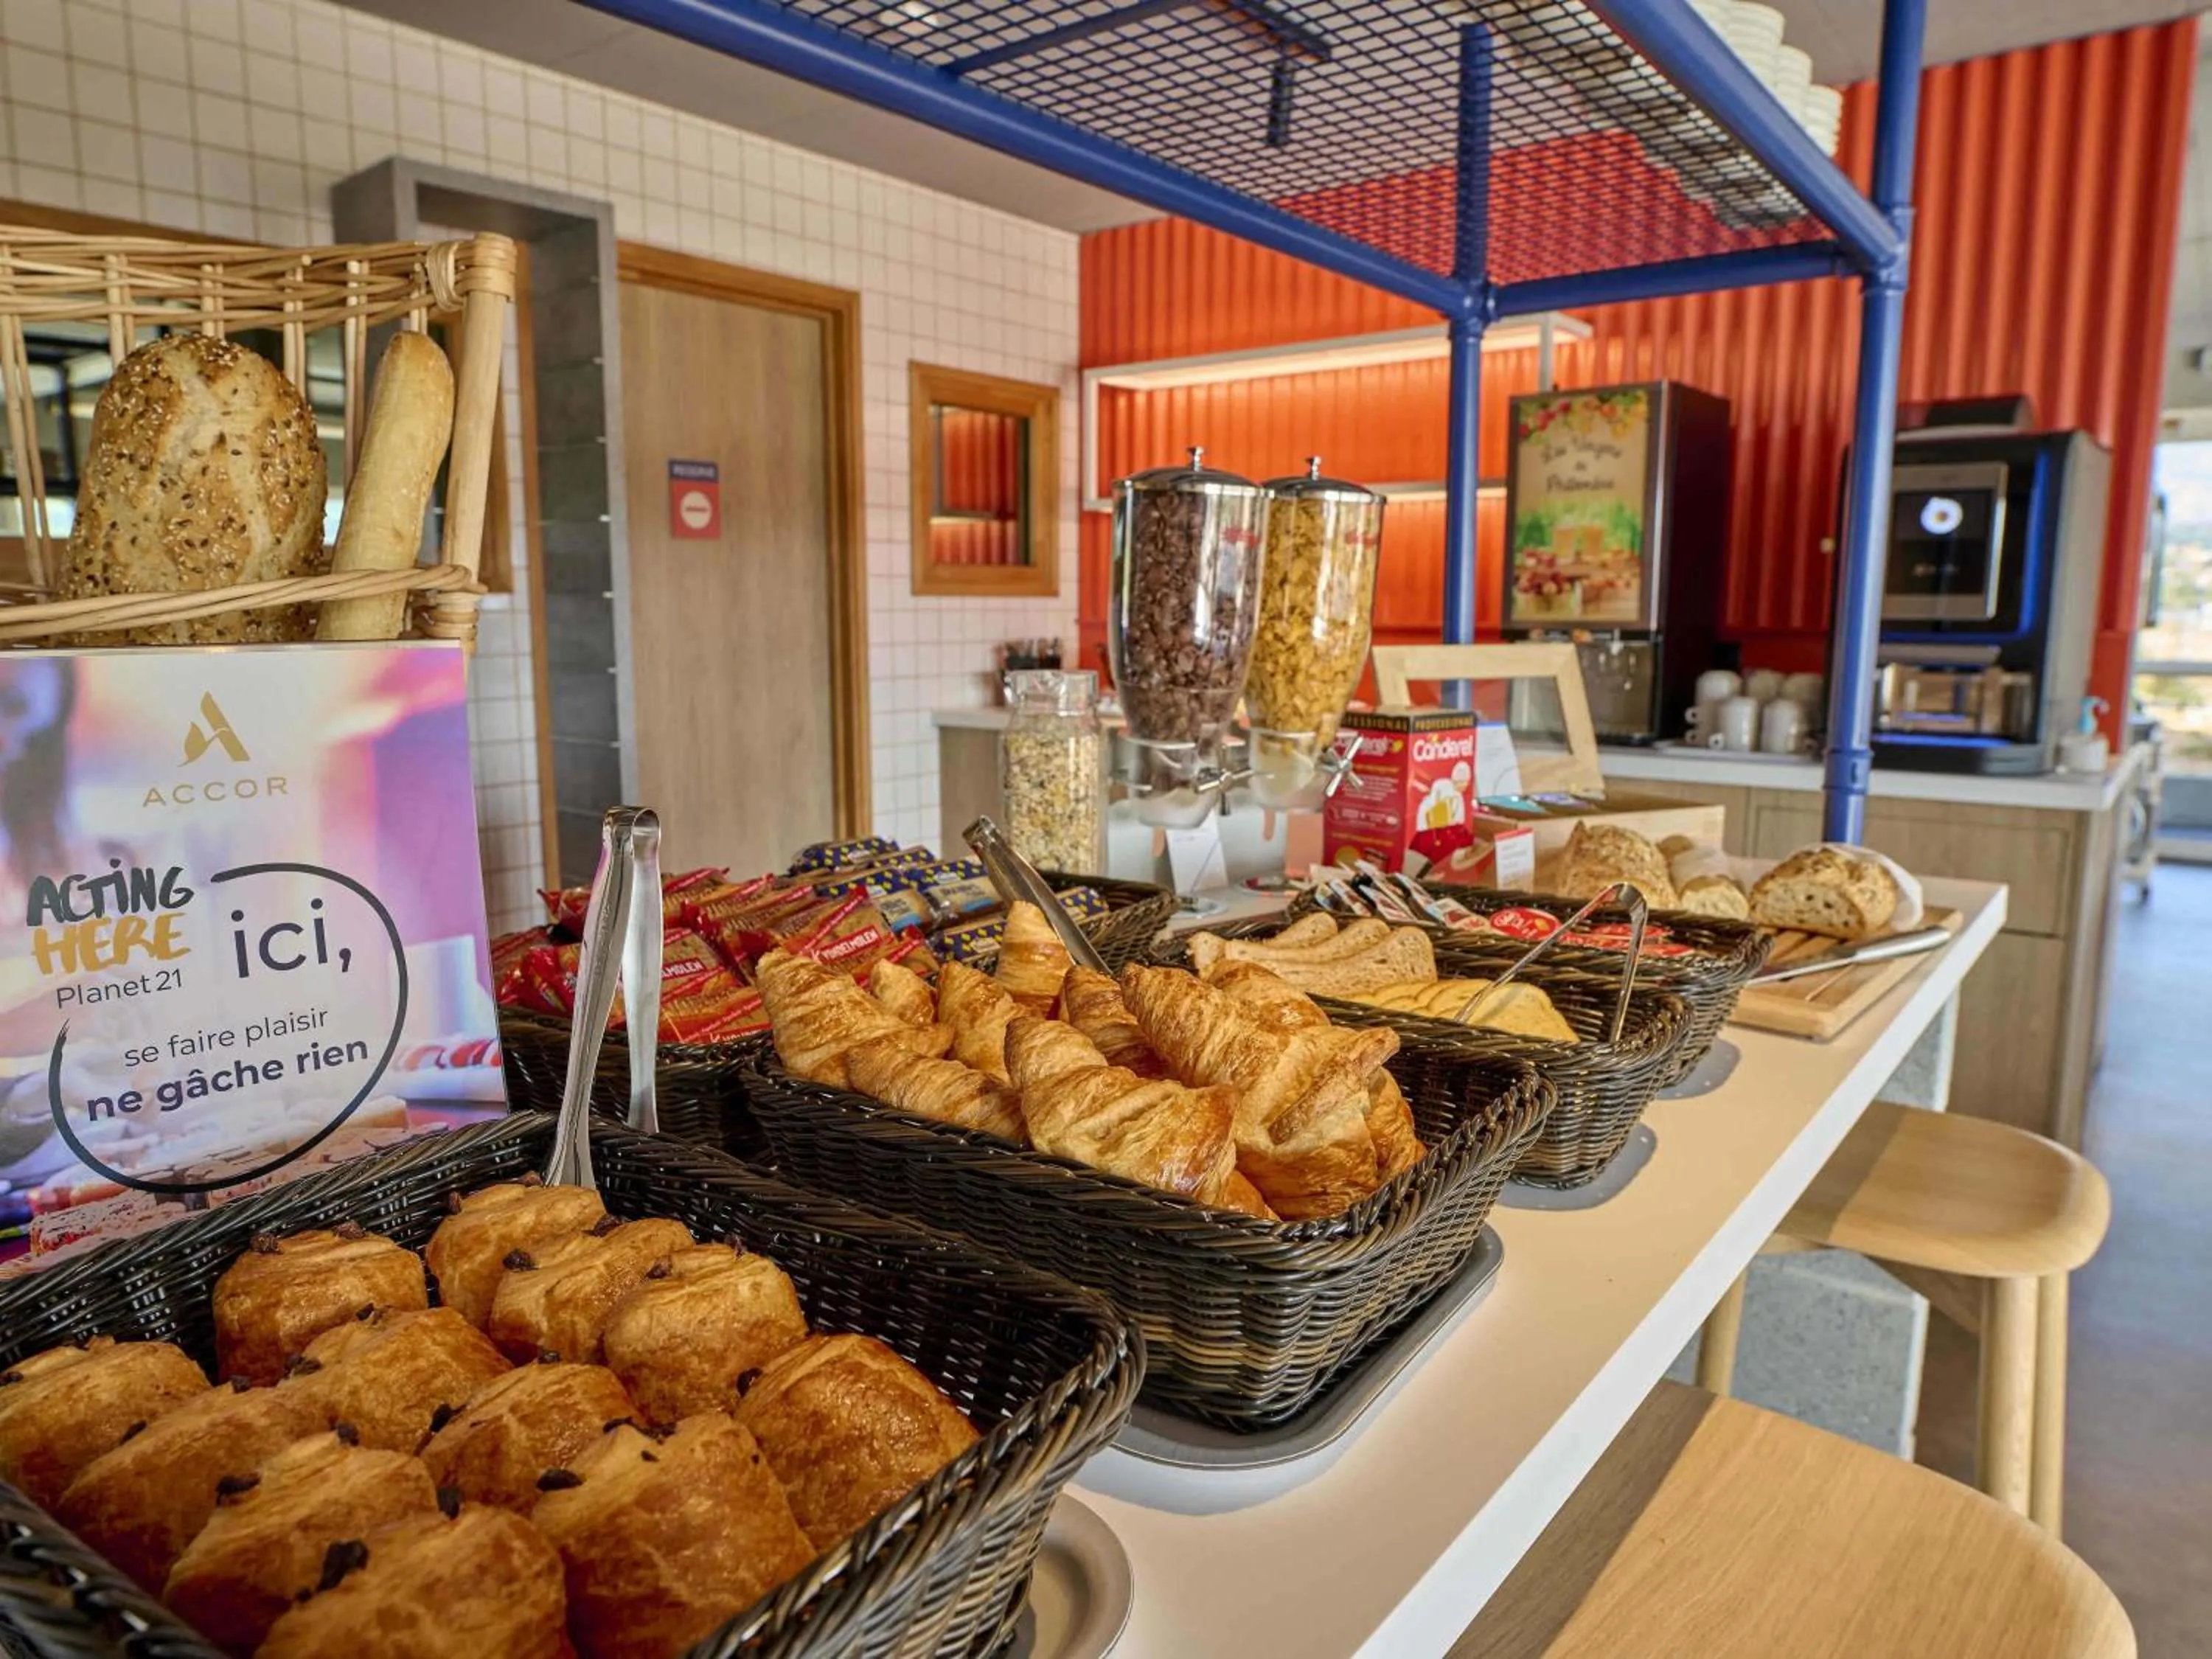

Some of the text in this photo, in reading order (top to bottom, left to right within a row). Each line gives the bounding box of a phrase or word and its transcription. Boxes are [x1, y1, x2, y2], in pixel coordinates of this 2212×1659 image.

[1413, 734, 1473, 762] Canderel
[142, 776, 288, 807] ACCOR
[32, 912, 191, 975] HERE
[232, 897, 352, 978] ici,
[124, 1008, 328, 1068] se faire plaisir
[87, 1040, 369, 1121] ne gâche rien
